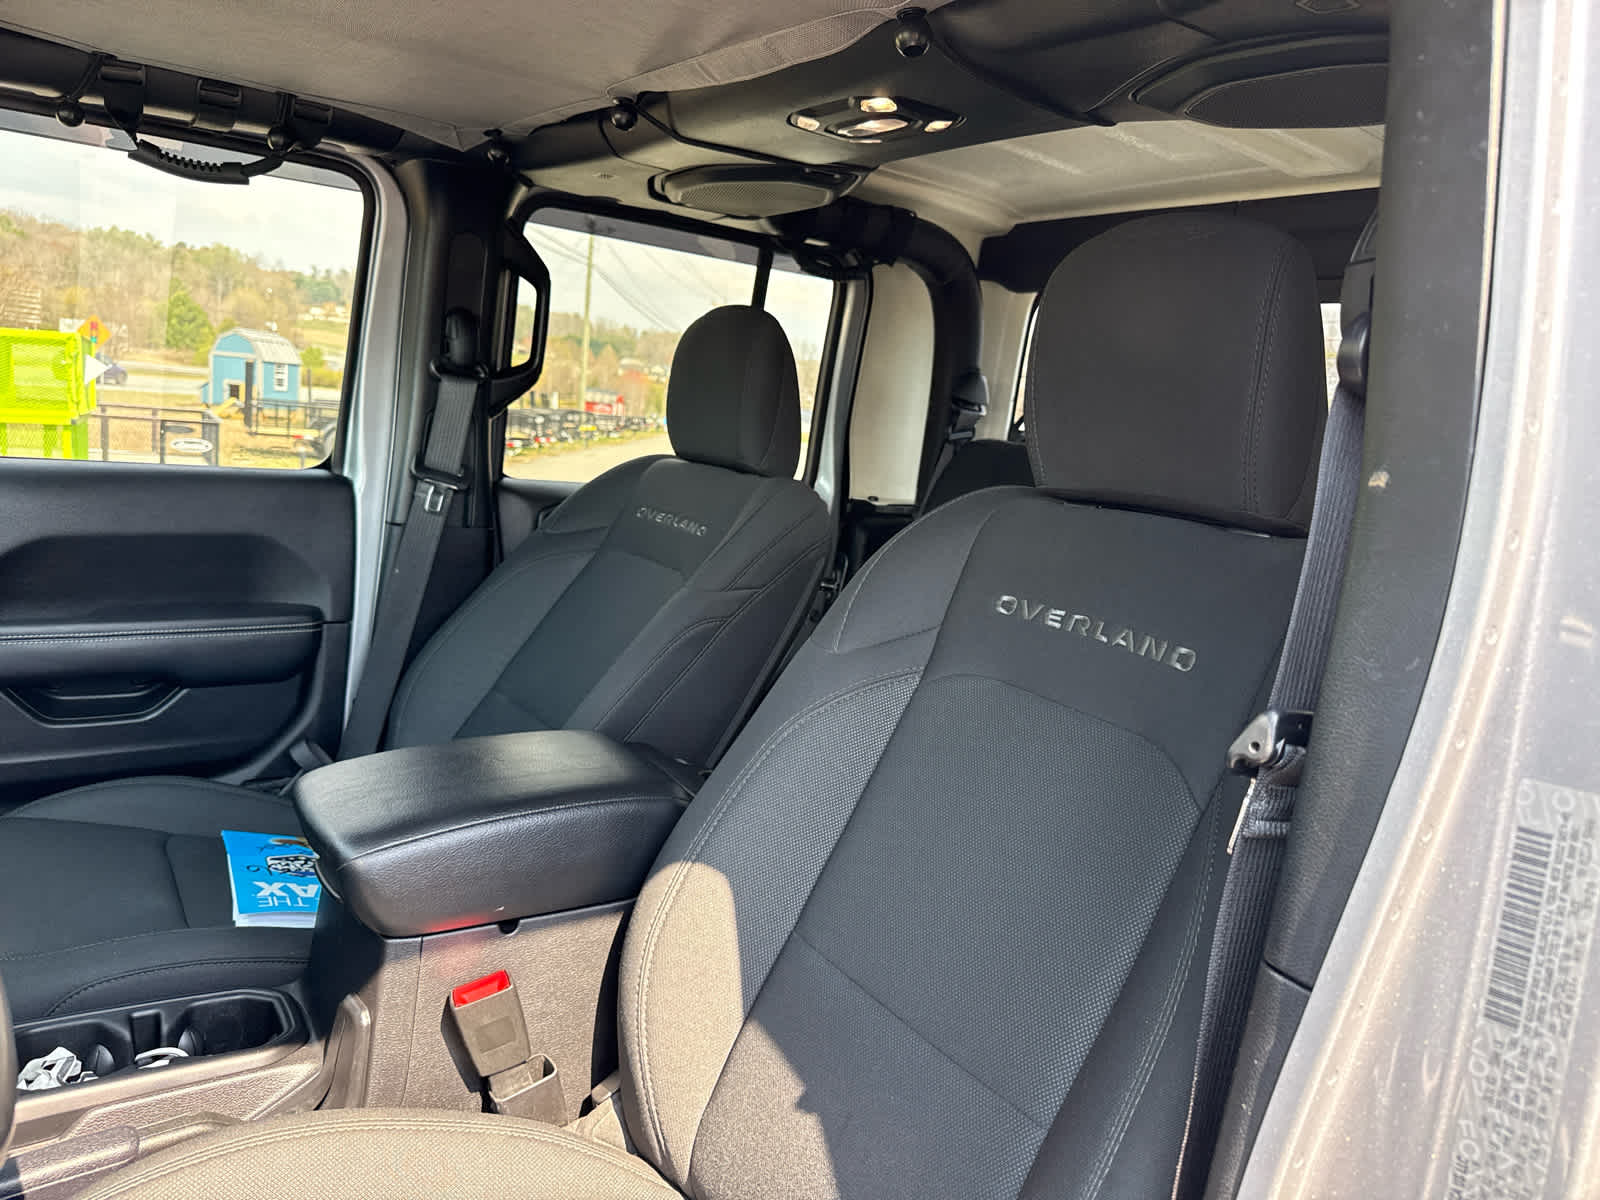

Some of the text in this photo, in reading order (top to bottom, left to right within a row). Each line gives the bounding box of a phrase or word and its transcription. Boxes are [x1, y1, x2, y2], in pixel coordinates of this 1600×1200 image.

[635, 505, 708, 537] OVERLAND
[994, 594, 1197, 672] OVERLAND
[257, 896, 310, 907] THE
